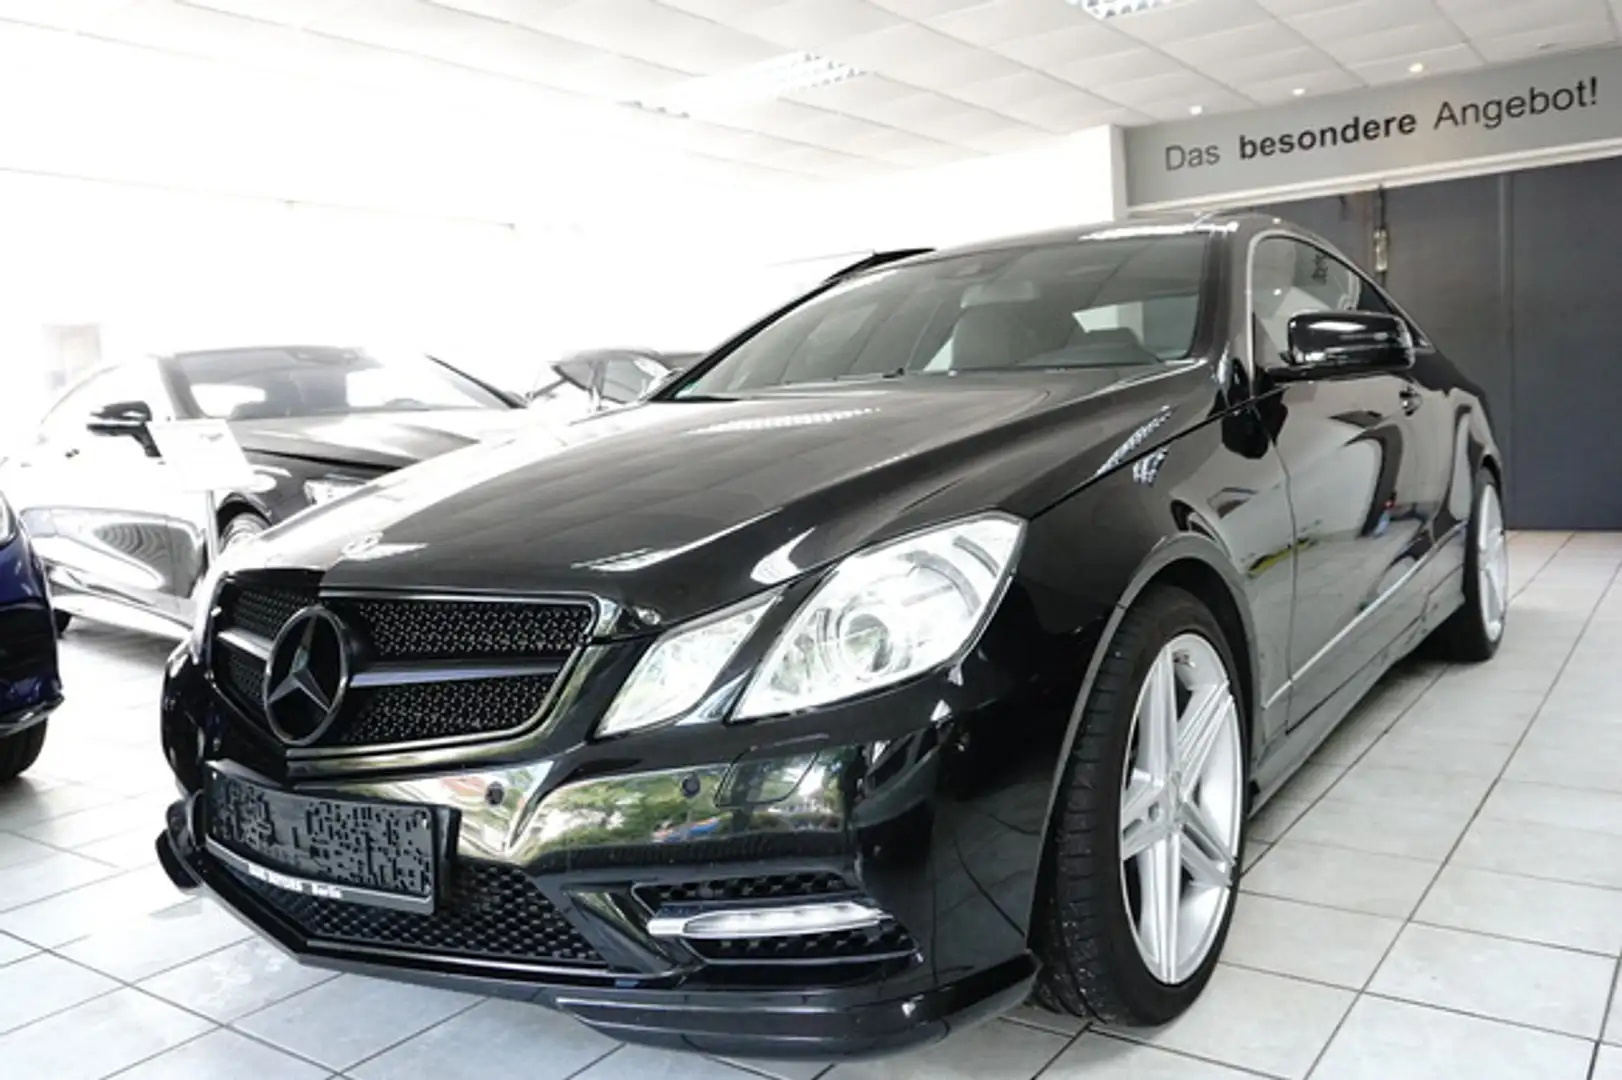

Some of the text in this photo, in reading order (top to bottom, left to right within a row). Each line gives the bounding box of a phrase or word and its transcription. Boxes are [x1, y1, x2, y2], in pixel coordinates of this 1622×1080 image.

[1165, 76, 1599, 172] Das besondere Angebot!
